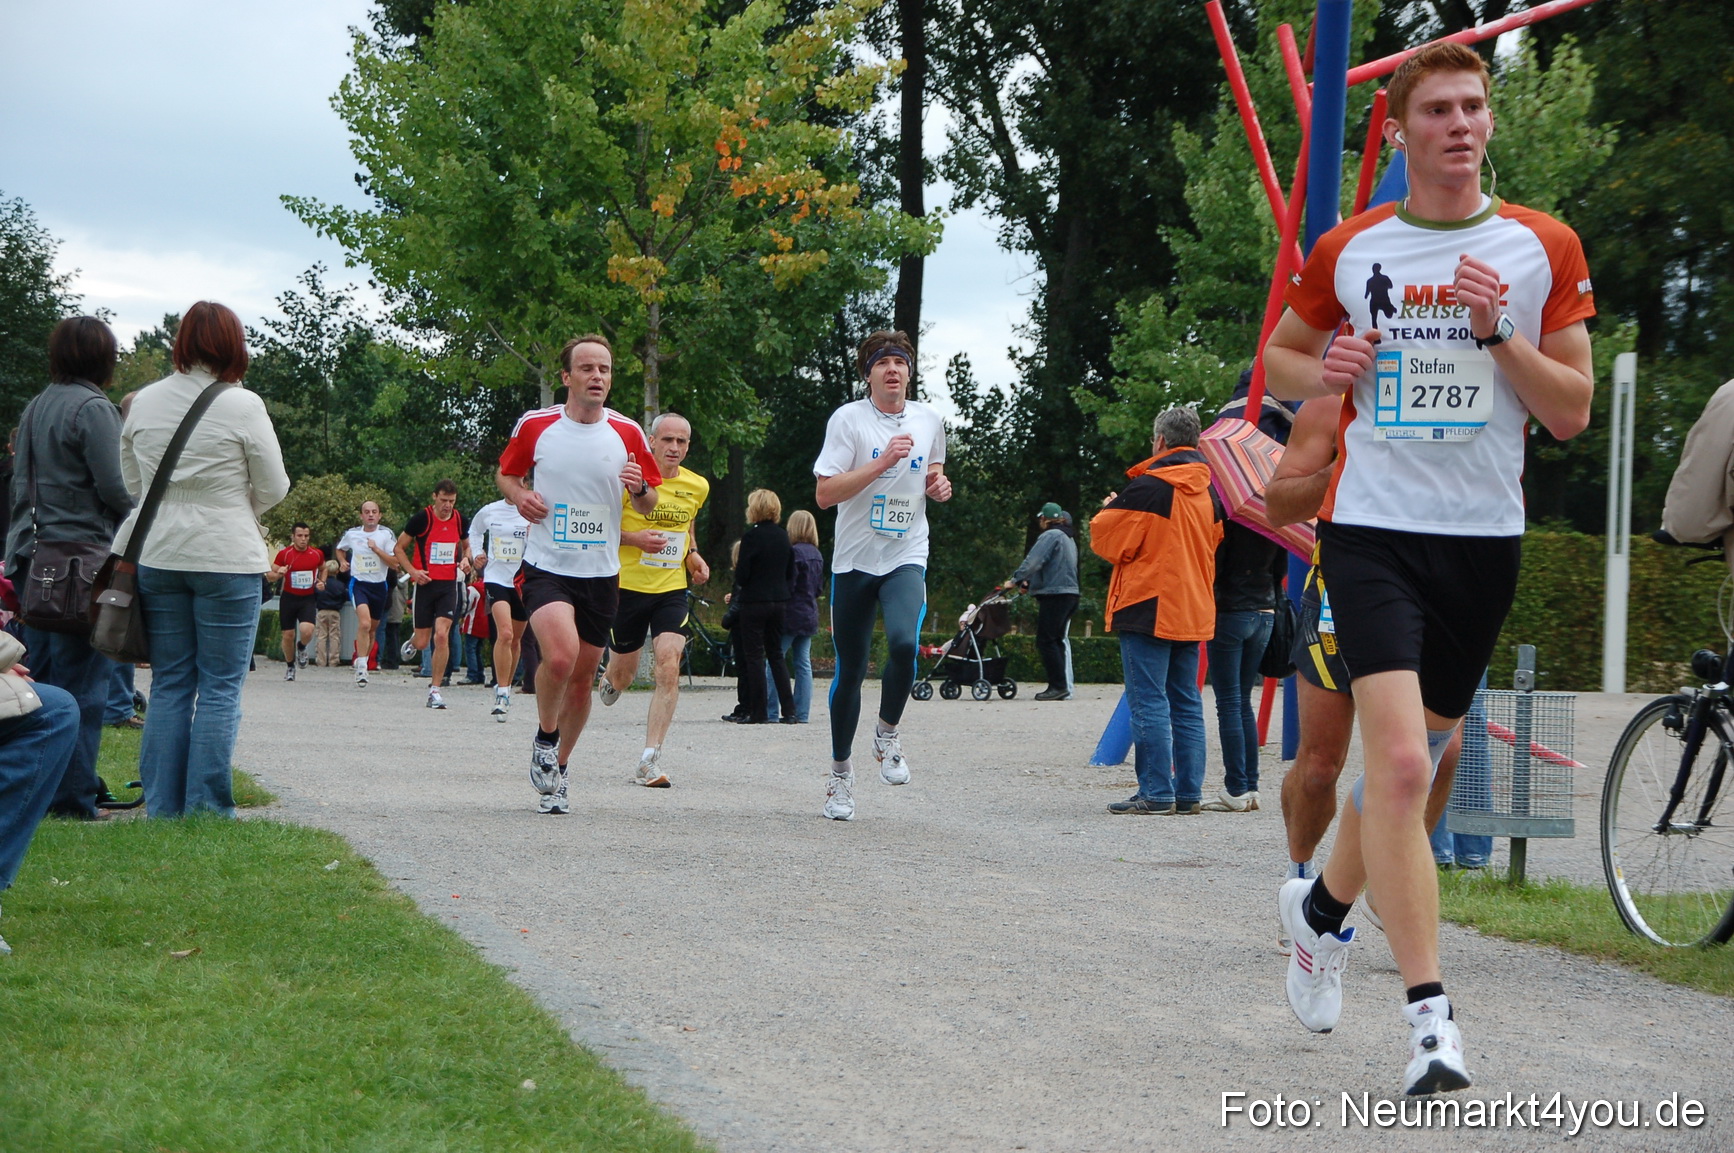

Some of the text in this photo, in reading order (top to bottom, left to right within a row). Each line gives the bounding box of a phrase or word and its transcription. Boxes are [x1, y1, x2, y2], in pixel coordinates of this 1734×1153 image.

[1404, 284, 1510, 307] MEZ
[1398, 300, 1472, 319] Reise
[1389, 328, 1441, 340] TEAM
[1410, 358, 1455, 374] Stefan
[1384, 384, 1391, 396] A
[1411, 385, 1480, 409] 2787
[889, 498, 910, 507] Alfred
[570, 507, 591, 517] Peter
[570, 521, 603, 535] 3094
